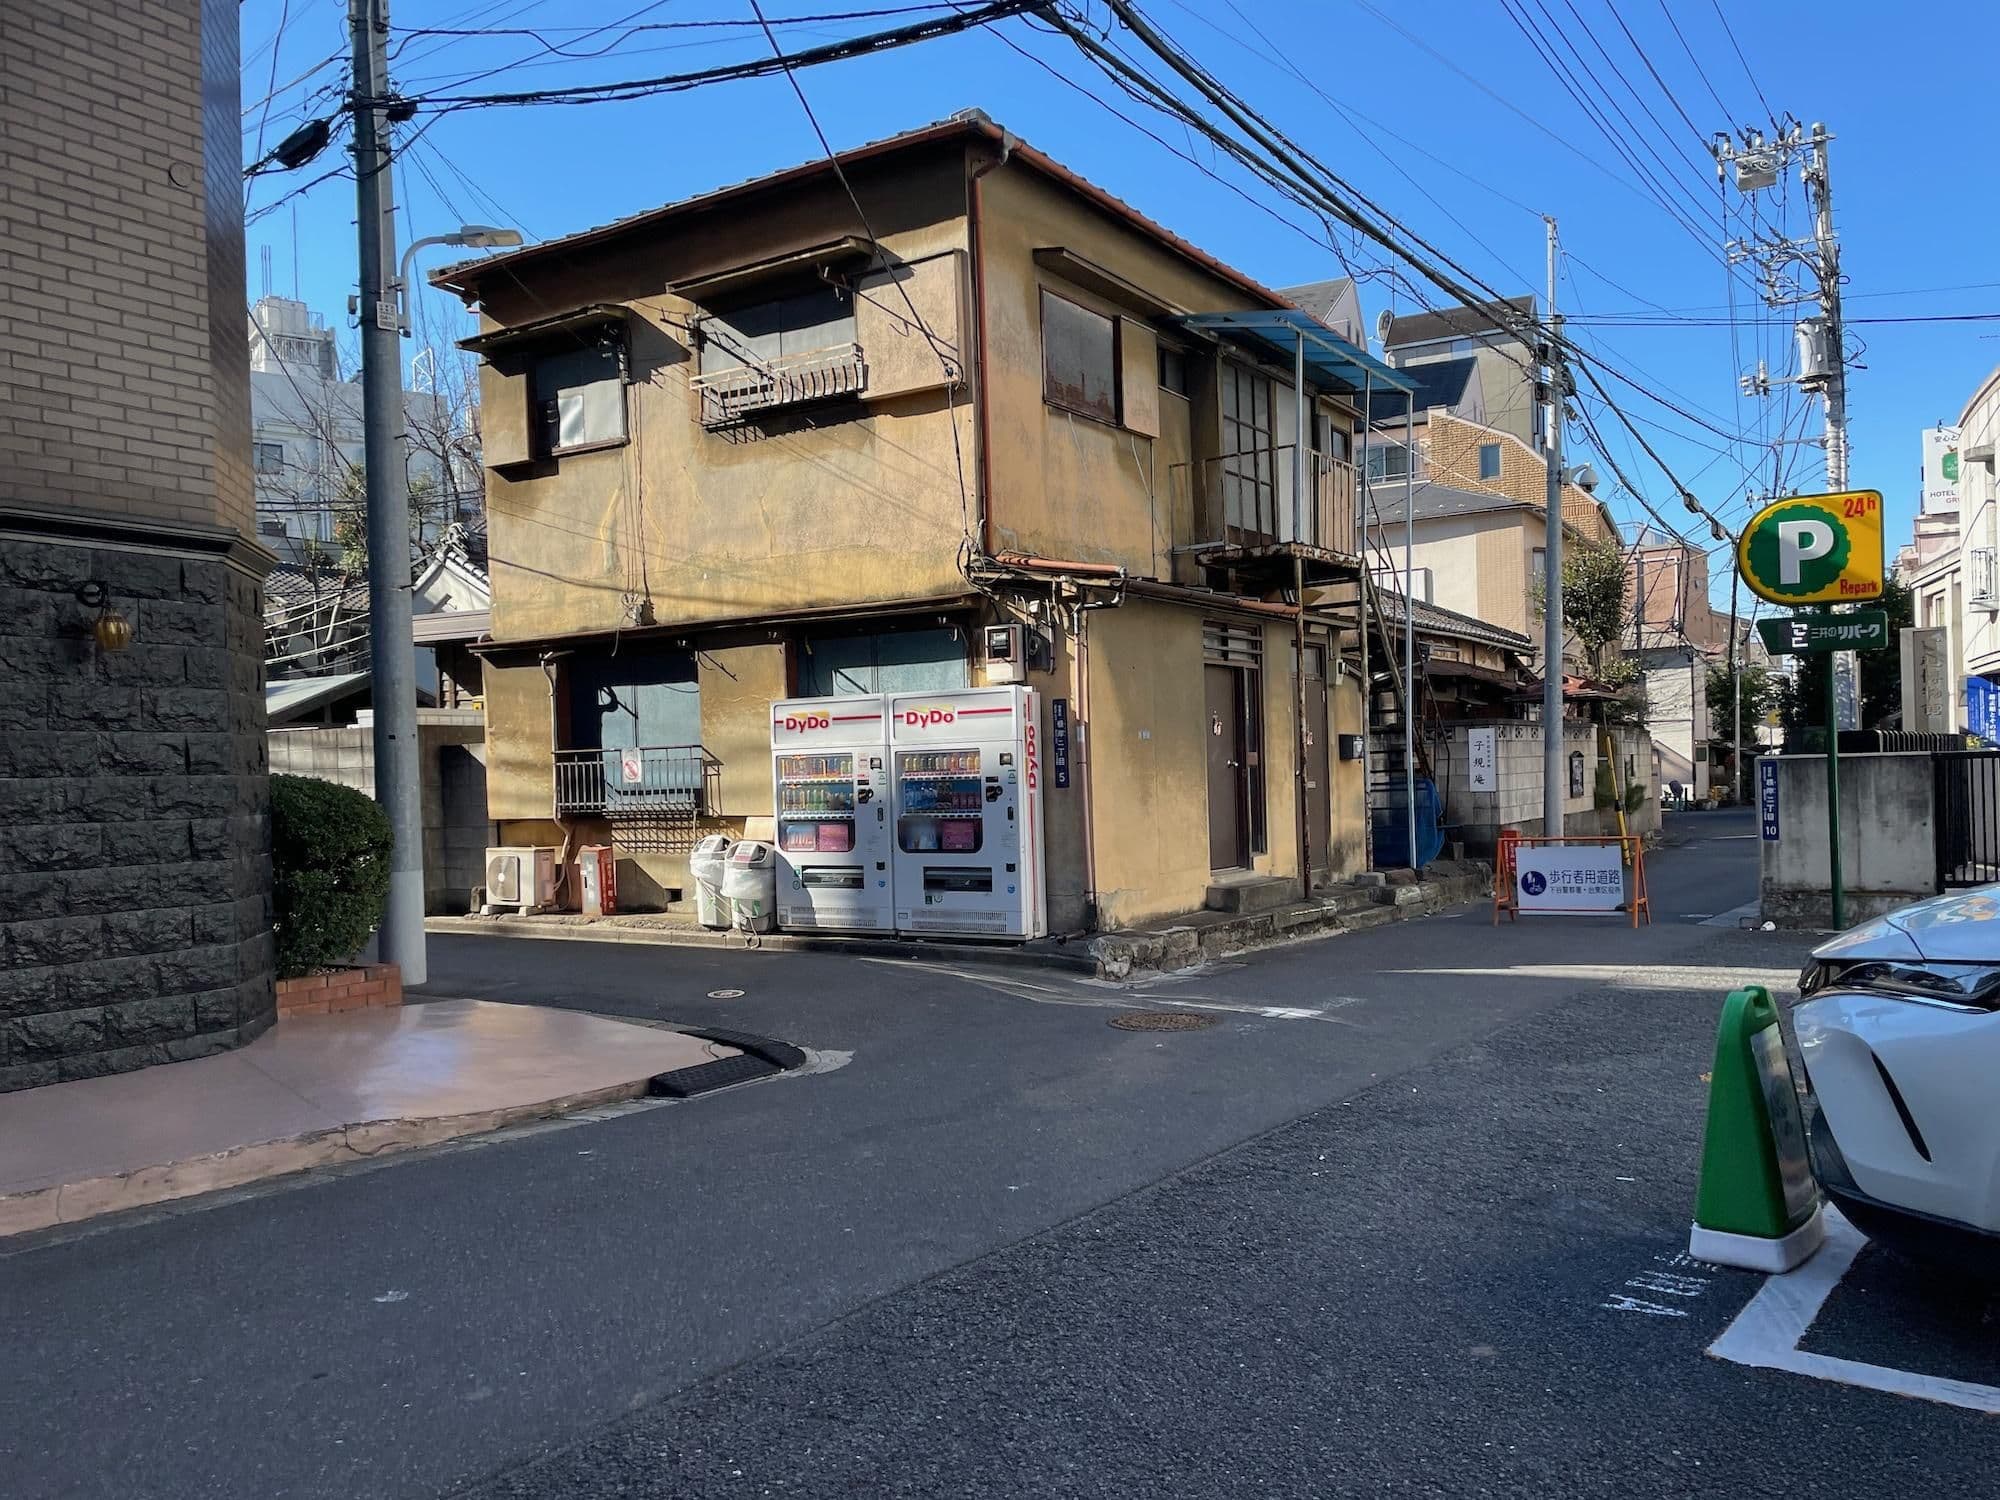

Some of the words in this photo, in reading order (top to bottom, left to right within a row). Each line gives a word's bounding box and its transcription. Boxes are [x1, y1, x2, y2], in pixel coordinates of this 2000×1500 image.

[1930, 489, 1956, 498] HOTEL
[1843, 497, 1877, 518] 24h
[1778, 520, 1835, 585] P
[1840, 579, 1878, 596] Repark
[1810, 624, 1881, 640] 三井のリパーク
[785, 716, 829, 733] DyDo
[906, 710, 954, 728] DyDo
[1027, 725, 1039, 788] DyDo
[1059, 772, 1066, 782] 5
[1766, 826, 1777, 836] 10
[1549, 869, 1620, 885] 歩行者用道路
